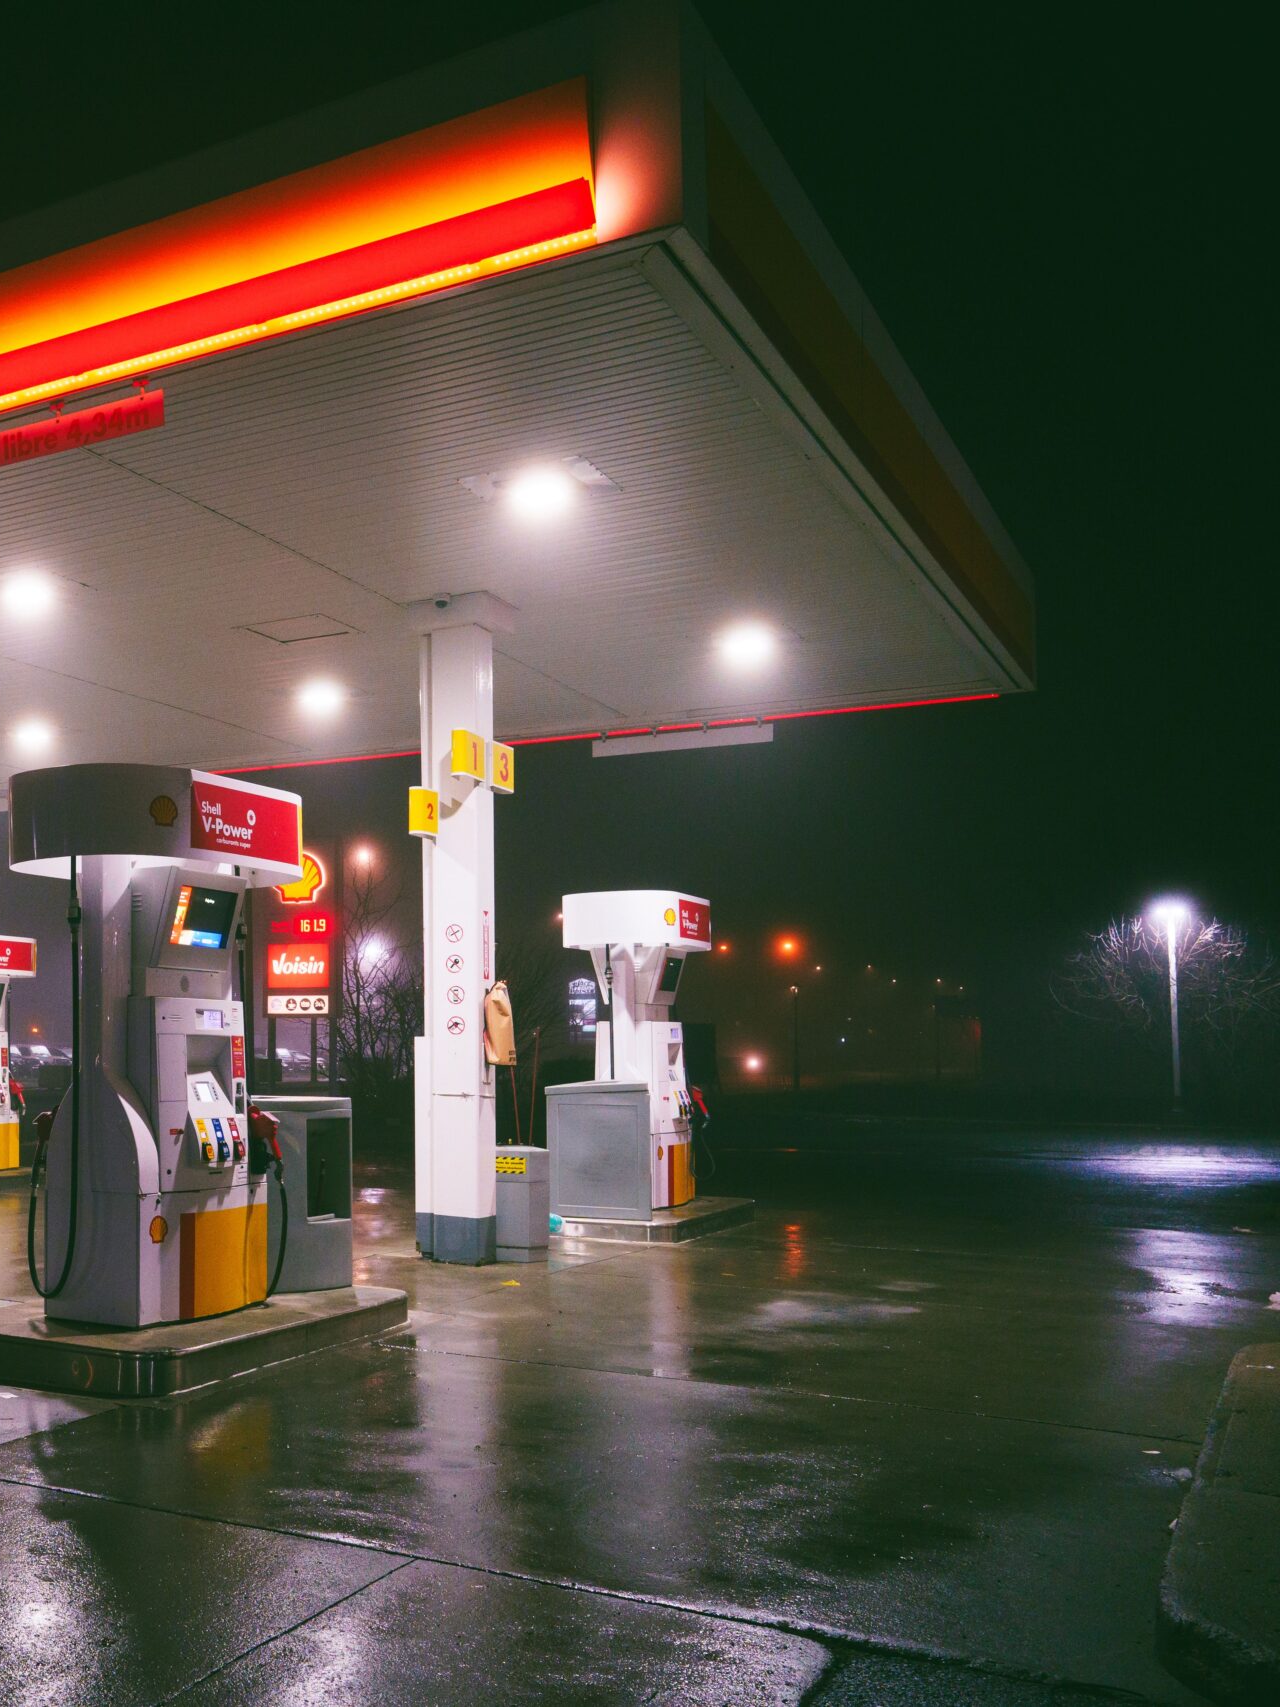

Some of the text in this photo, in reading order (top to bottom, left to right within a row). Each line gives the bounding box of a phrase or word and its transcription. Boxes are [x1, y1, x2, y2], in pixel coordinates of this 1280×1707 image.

[3, 432, 58, 462] libre
[67, 406, 149, 443] 4,34m
[472, 742, 478, 771] 1
[500, 752, 509, 782] 3
[201, 801, 222, 816] Shell
[427, 803, 434, 820] 2
[202, 815, 253, 840] V-Power
[271, 952, 325, 975] Voisin
